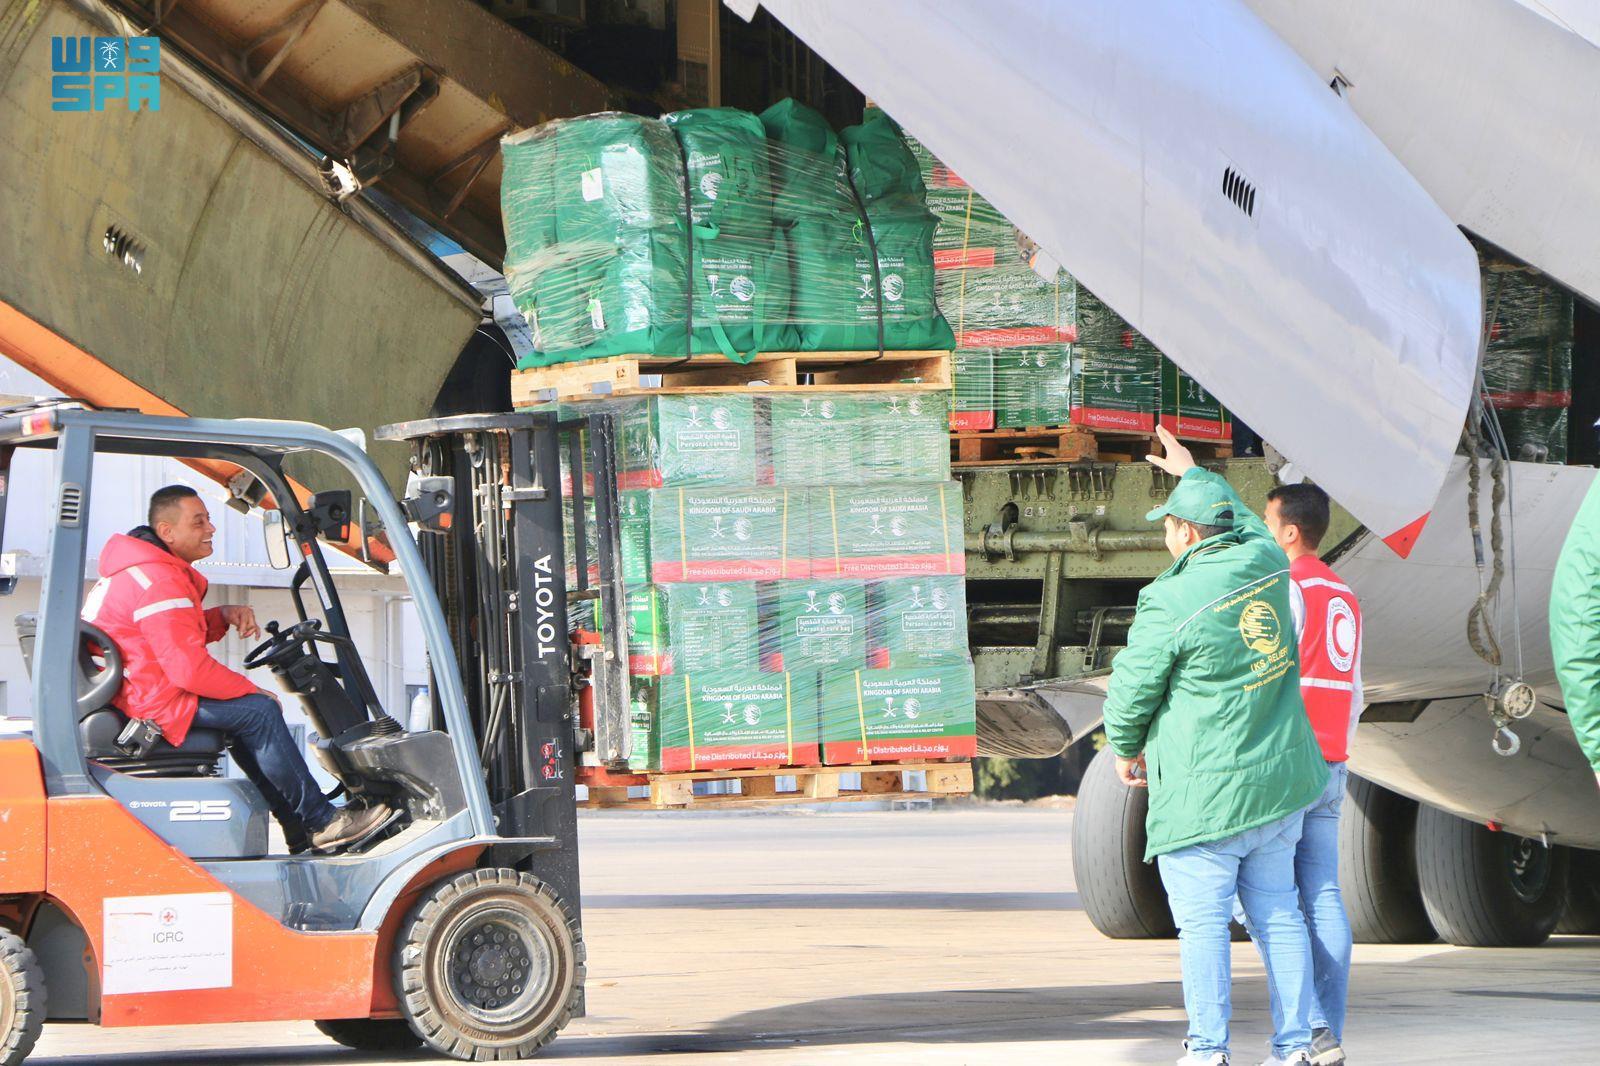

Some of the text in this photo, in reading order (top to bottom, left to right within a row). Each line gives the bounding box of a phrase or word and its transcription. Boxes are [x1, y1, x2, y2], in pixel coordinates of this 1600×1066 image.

[688, 506, 721, 515] KINGDOM
[721, 506, 731, 514] OF
[752, 506, 777, 514] ARABIA
[849, 506, 879, 514] KINGDOM
[906, 504, 929, 512] ARABIA
[702, 567, 742, 577] Distributed
[861, 562, 899, 572] Distributed
[533, 554, 556, 660] TOYOTA
[862, 677, 941, 688] المملكة العربية السعودية
[863, 689, 893, 697] KINGDOM
[920, 687, 942, 695] ARABIA
[873, 745, 913, 754] Distributed
[694, 751, 751, 761] Free Distributed
[140, 800, 168, 808] TOYOTA
[169, 799, 232, 822] 25
[152, 931, 184, 943] ICRC
